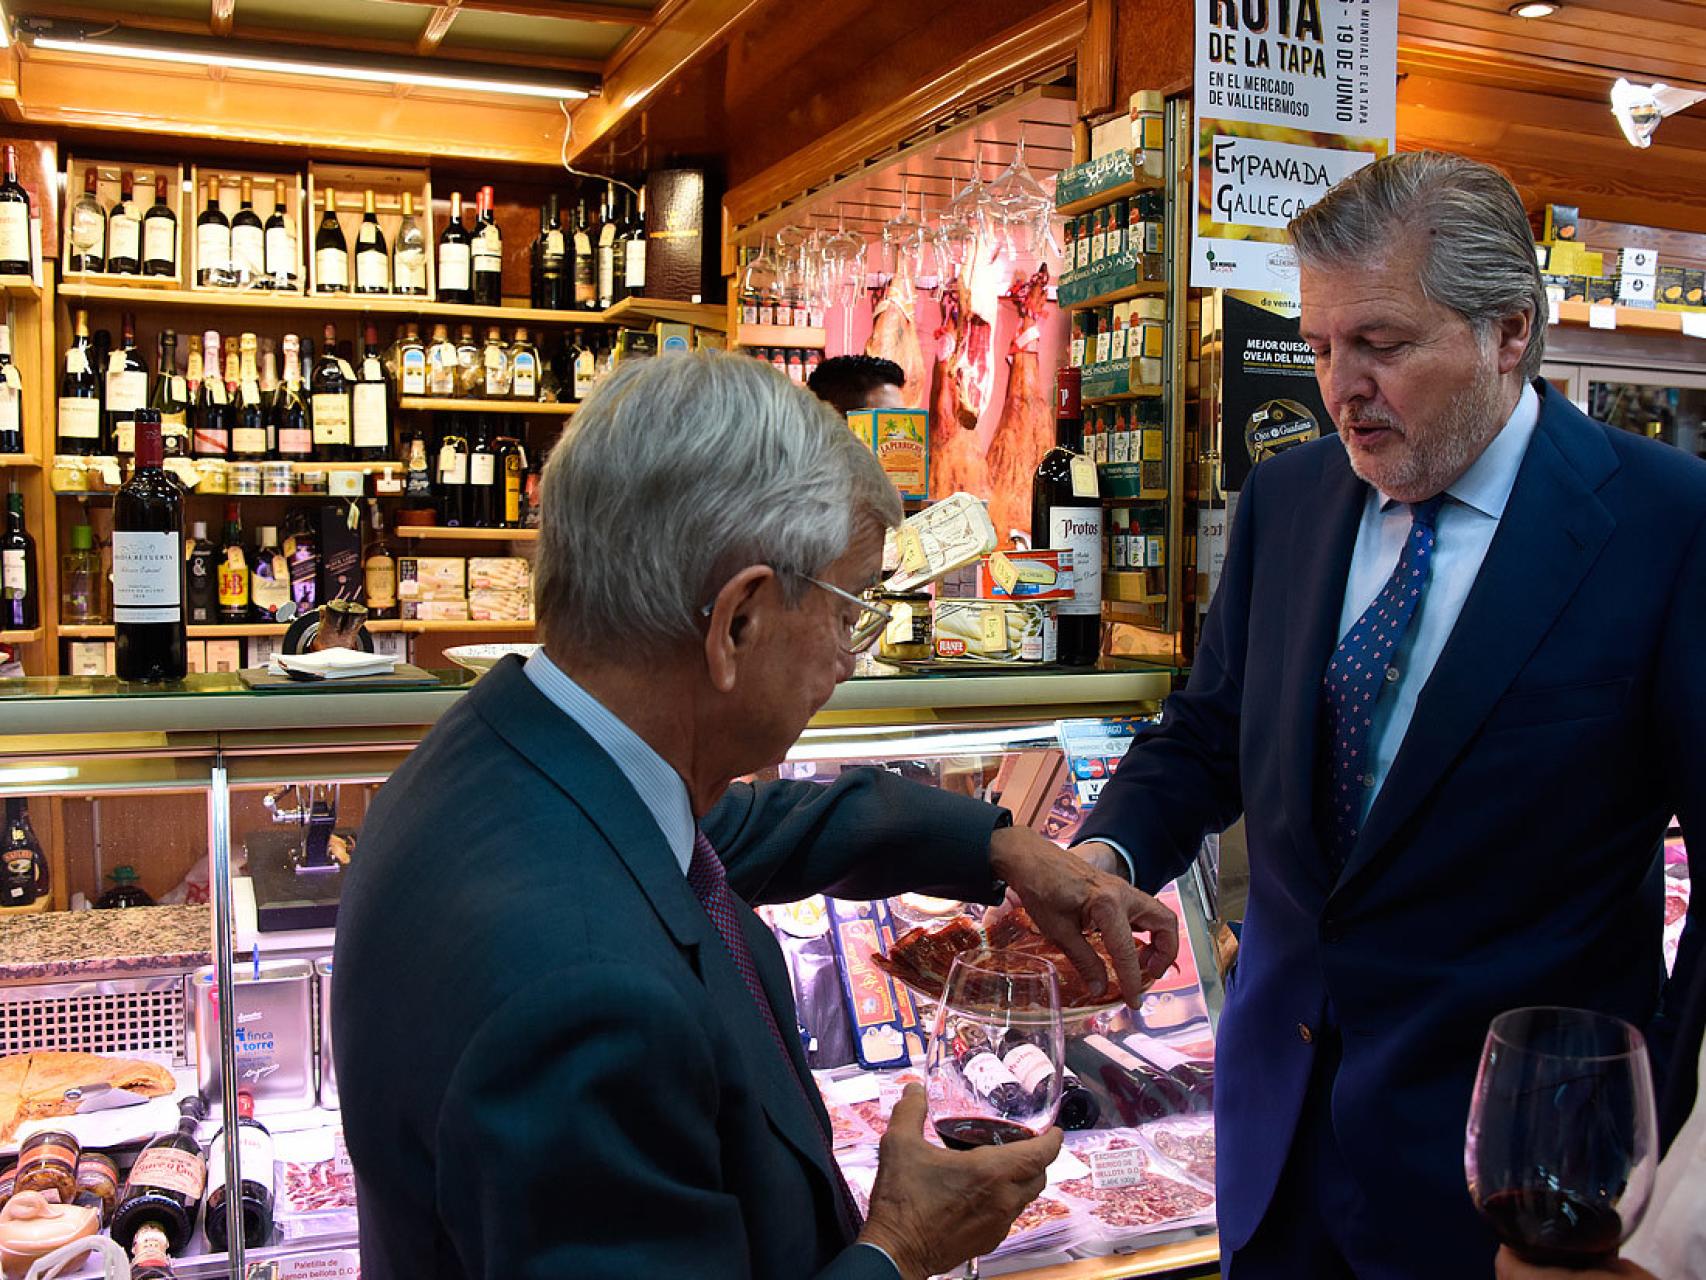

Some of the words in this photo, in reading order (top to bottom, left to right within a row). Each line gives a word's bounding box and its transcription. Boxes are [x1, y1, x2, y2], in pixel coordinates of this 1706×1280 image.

[1337, 25, 1354, 43] 19
[1360, 9, 1370, 59] MUNDIAL
[1209, 32, 1237, 66] DE
[1244, 36, 1270, 69] LA
[1276, 41, 1327, 80] TAPA
[1336, 49, 1353, 70] DE
[1360, 65, 1369, 77] DE
[1209, 71, 1224, 88] EN
[1227, 73, 1241, 89] EL
[1243, 75, 1295, 97] MERCADO
[1360, 82, 1369, 93] LA
[1209, 90, 1223, 106] DE
[1226, 92, 1310, 117] VALLEHERMOSO
[1336, 74, 1353, 122] JUNIO
[1360, 100, 1369, 124] TAPA
[1215, 140, 1332, 187] EMPANADA
[1261, 297, 1272, 307] de
[1273, 300, 1297, 309] venta
[1246, 338, 1279, 350] MEJOR
[1280, 341, 1310, 353] QUESO
[1243, 351, 1273, 363] OVEJA
[1274, 354, 1291, 364] DEL
[1292, 354, 1316, 365] MUN
[1061, 518, 1099, 539] Protos
[247, 1031, 273, 1041] finca
[243, 1041, 273, 1051] torre
[294, 1260, 326, 1270] Paletilla
[327, 1259, 338, 1267] de
